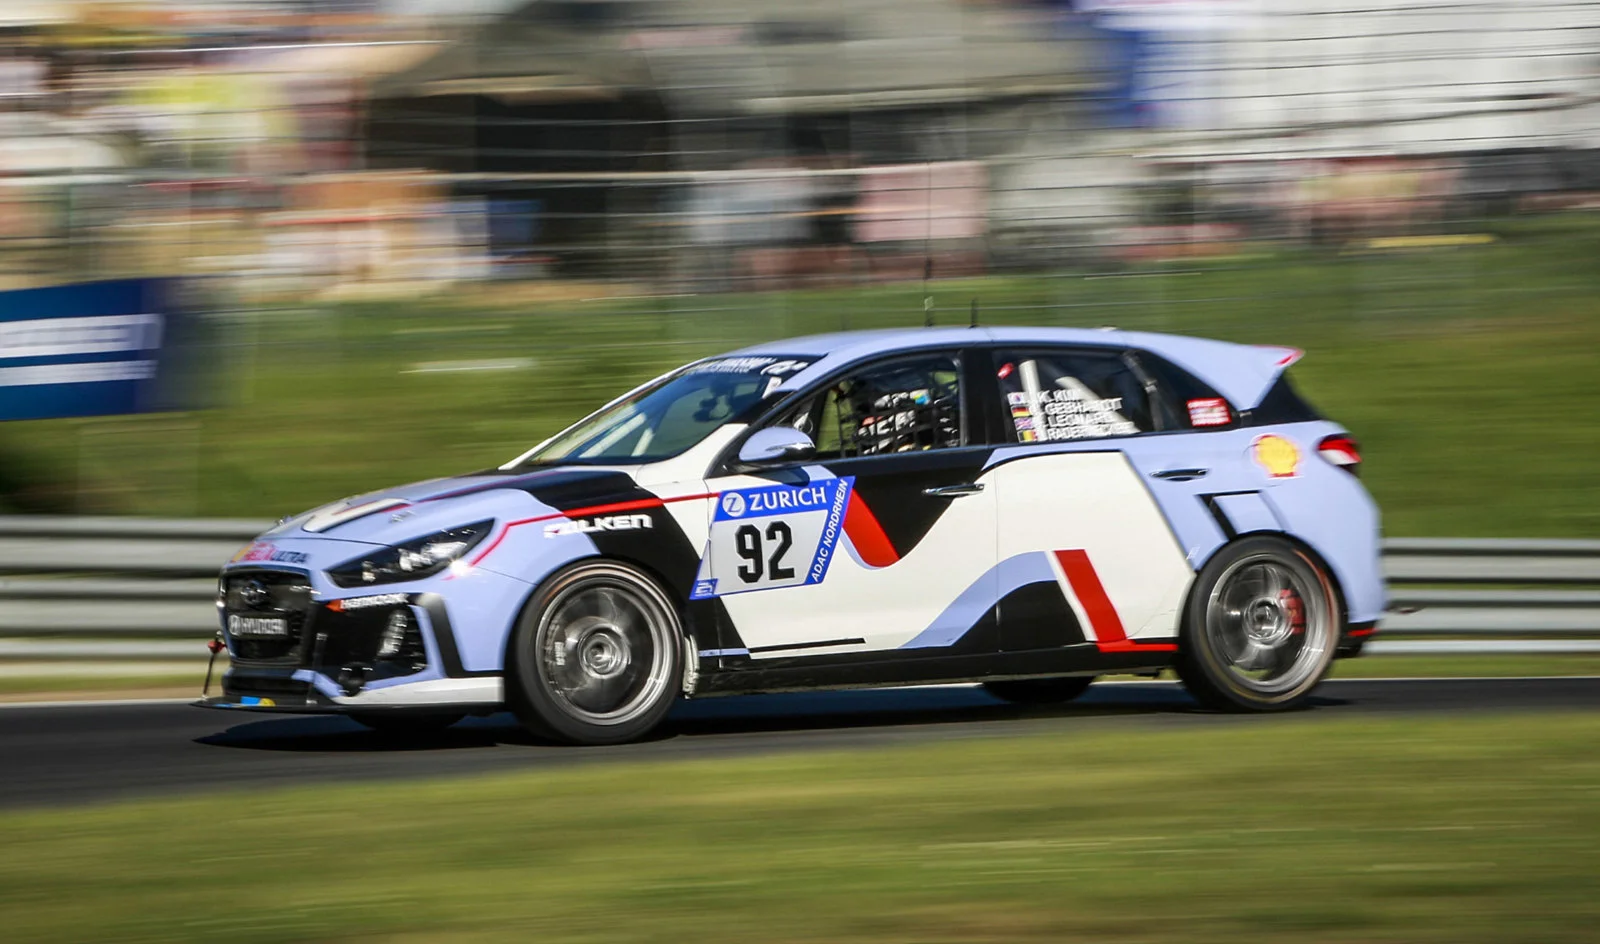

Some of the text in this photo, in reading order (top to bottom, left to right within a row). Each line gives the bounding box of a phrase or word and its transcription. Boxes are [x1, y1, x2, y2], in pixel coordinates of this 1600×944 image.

[749, 487, 827, 511] ZURICH
[810, 479, 849, 583] ADAC NORDRHEIN
[735, 520, 795, 584] 92
